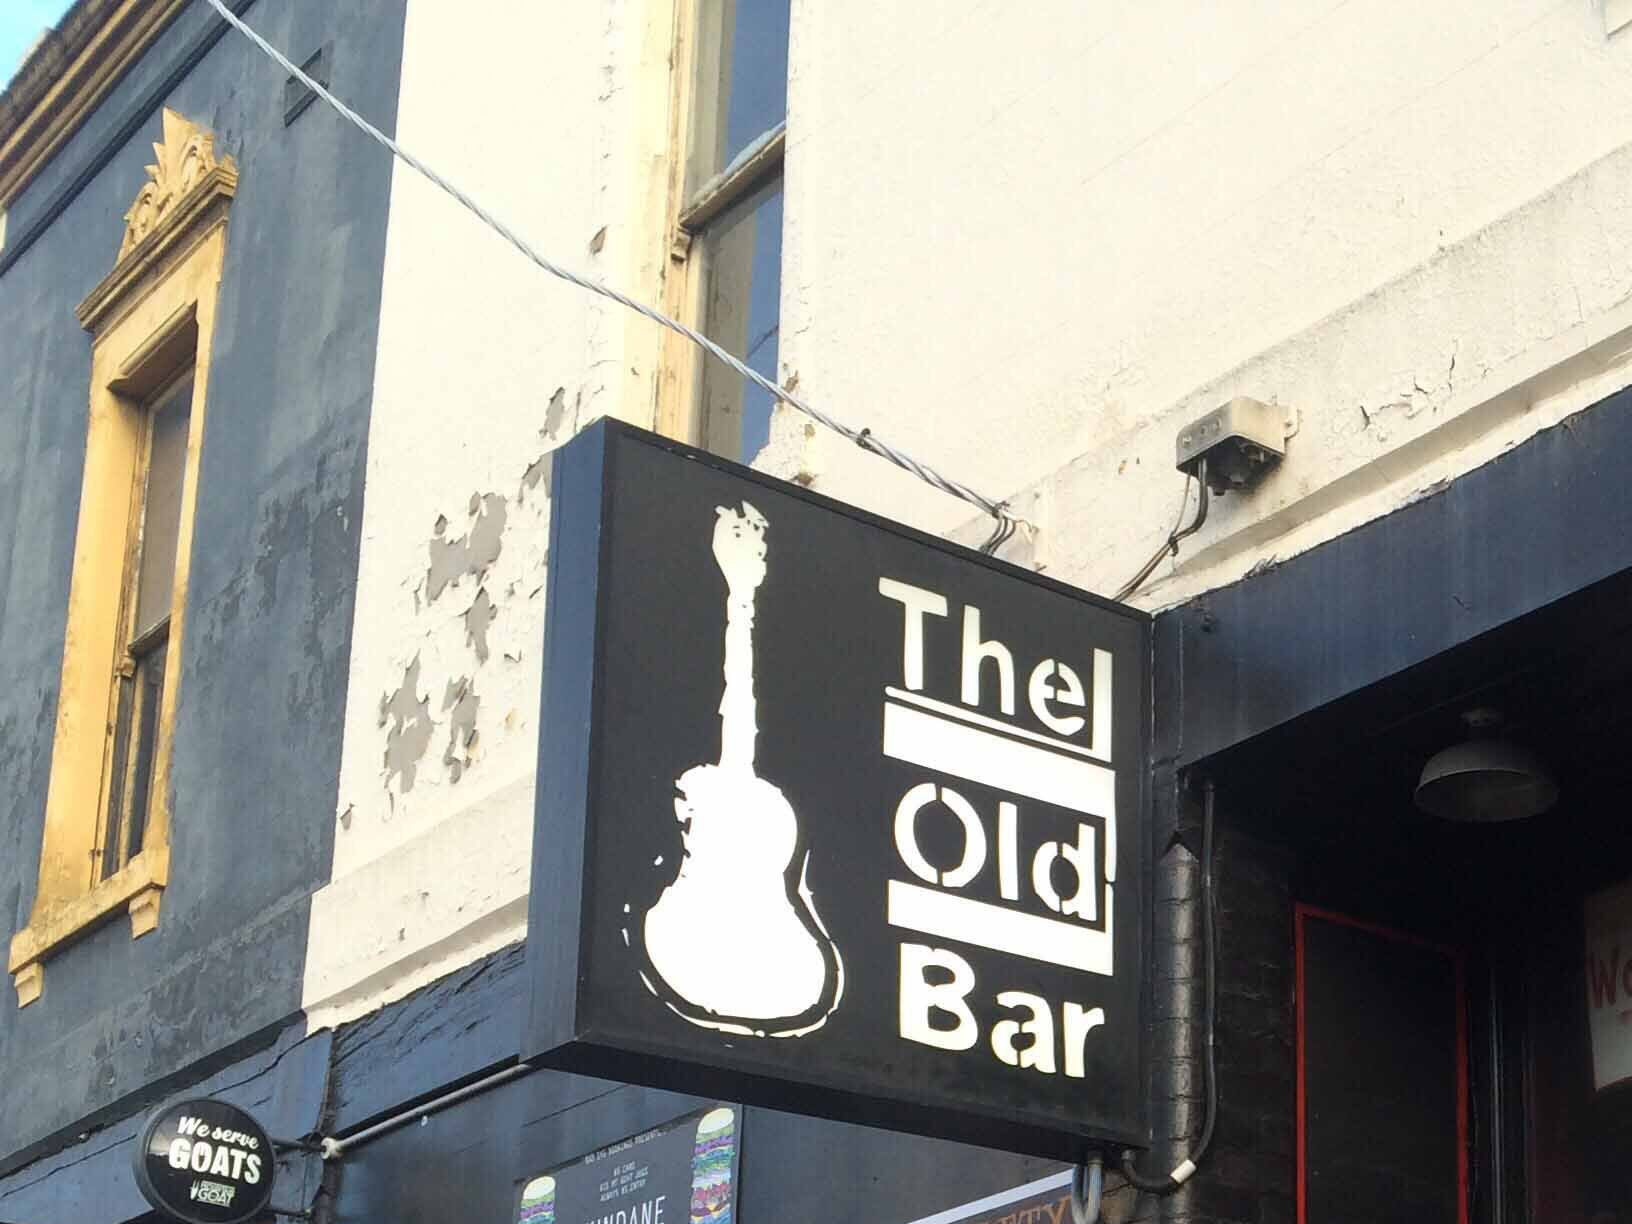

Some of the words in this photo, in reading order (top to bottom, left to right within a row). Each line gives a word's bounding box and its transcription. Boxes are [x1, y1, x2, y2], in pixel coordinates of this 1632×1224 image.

[878, 576, 1086, 737] The
[894, 782, 1097, 922] Old
[899, 942, 1105, 1078] Bar
[168, 1138, 262, 1185] GOATS
[177, 1115, 210, 1138] We
[211, 1126, 260, 1150] serve
